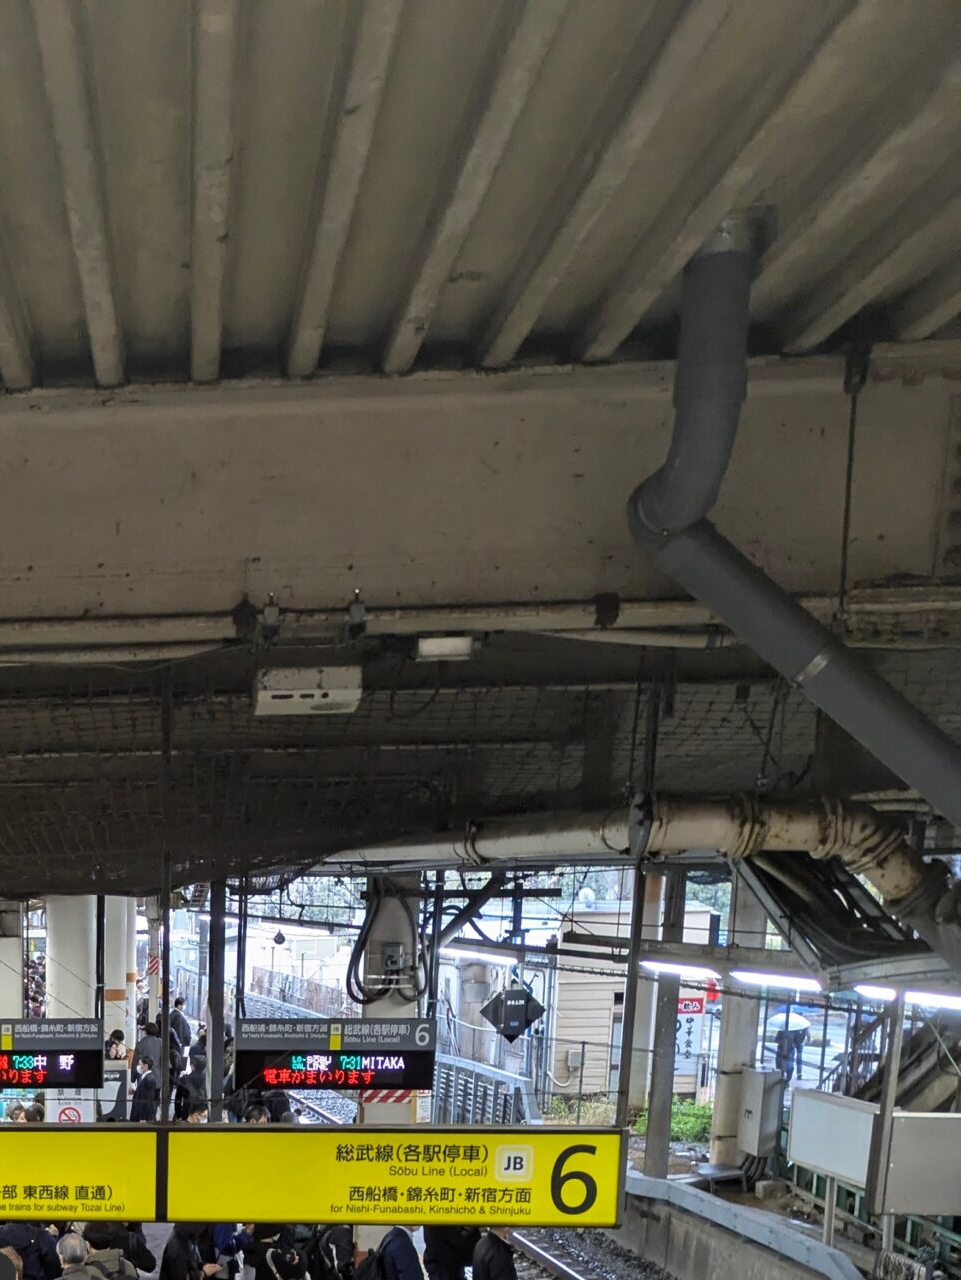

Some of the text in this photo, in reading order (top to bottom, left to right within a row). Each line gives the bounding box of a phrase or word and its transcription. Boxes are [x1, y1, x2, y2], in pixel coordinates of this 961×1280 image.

[415, 1023, 430, 1046] 6
[264, 1070, 375, 1085] 電車がまいります
[336, 1144, 488, 1163] 総武線(各駅停車)
[389, 1165, 488, 1177] Sōbu Line (Local)
[503, 1156, 524, 1171] JB
[550, 1144, 597, 1215] 6
[23, 1185, 69, 1200] 東西線
[75, 1185, 113, 1200] 直通)
[349, 1186, 532, 1203] 西船橋・錦糸町・新宿方面
[34, 1203, 44, 1211] for
[47, 1205, 77, 1213] subway
[104, 1204, 125, 1212] Line)
[330, 1204, 343, 1213] for
[345, 1204, 426, 1214] Nishi-Funabashi,
[489, 1206, 531, 1217] Shinjuku
